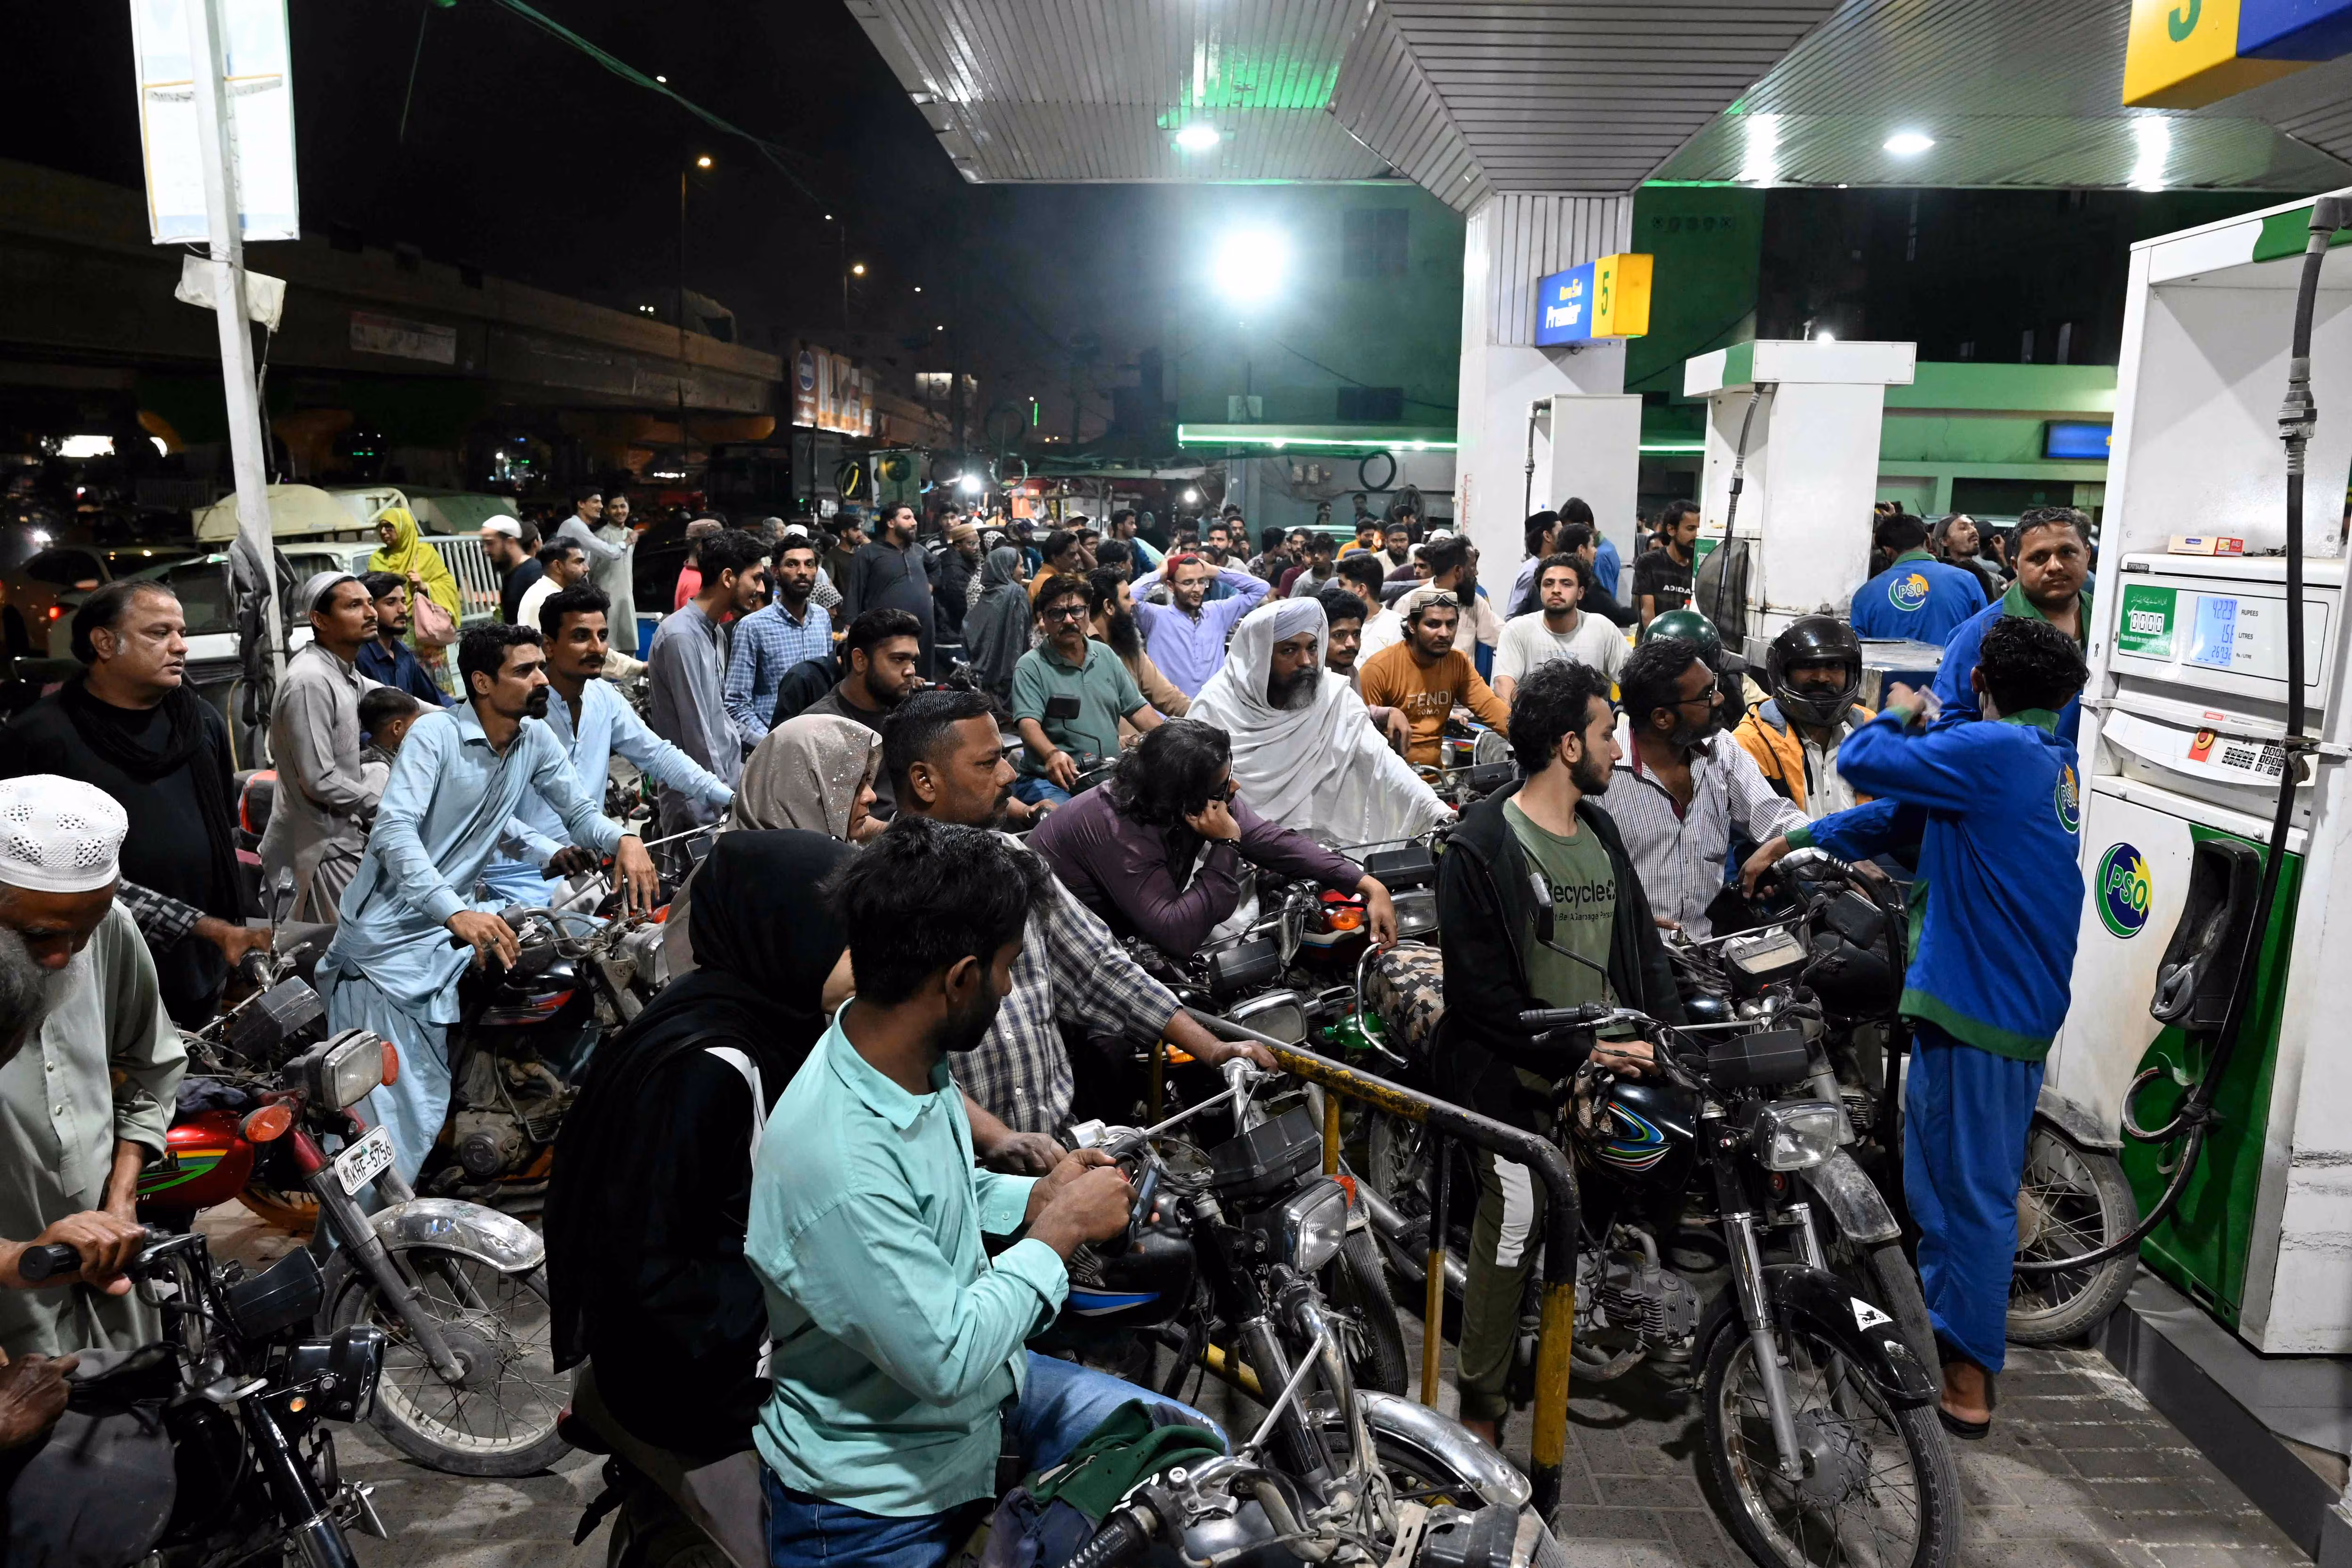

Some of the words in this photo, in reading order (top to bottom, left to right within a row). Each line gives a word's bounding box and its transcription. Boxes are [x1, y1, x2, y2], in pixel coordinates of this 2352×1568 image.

[1601, 270, 1610, 317] 5
[1663, 585, 1693, 594] ADIDA
[1898, 582, 1923, 599] PSO
[1407, 690, 1452, 709] FENDI
[2106, 863, 2148, 911] PSO
